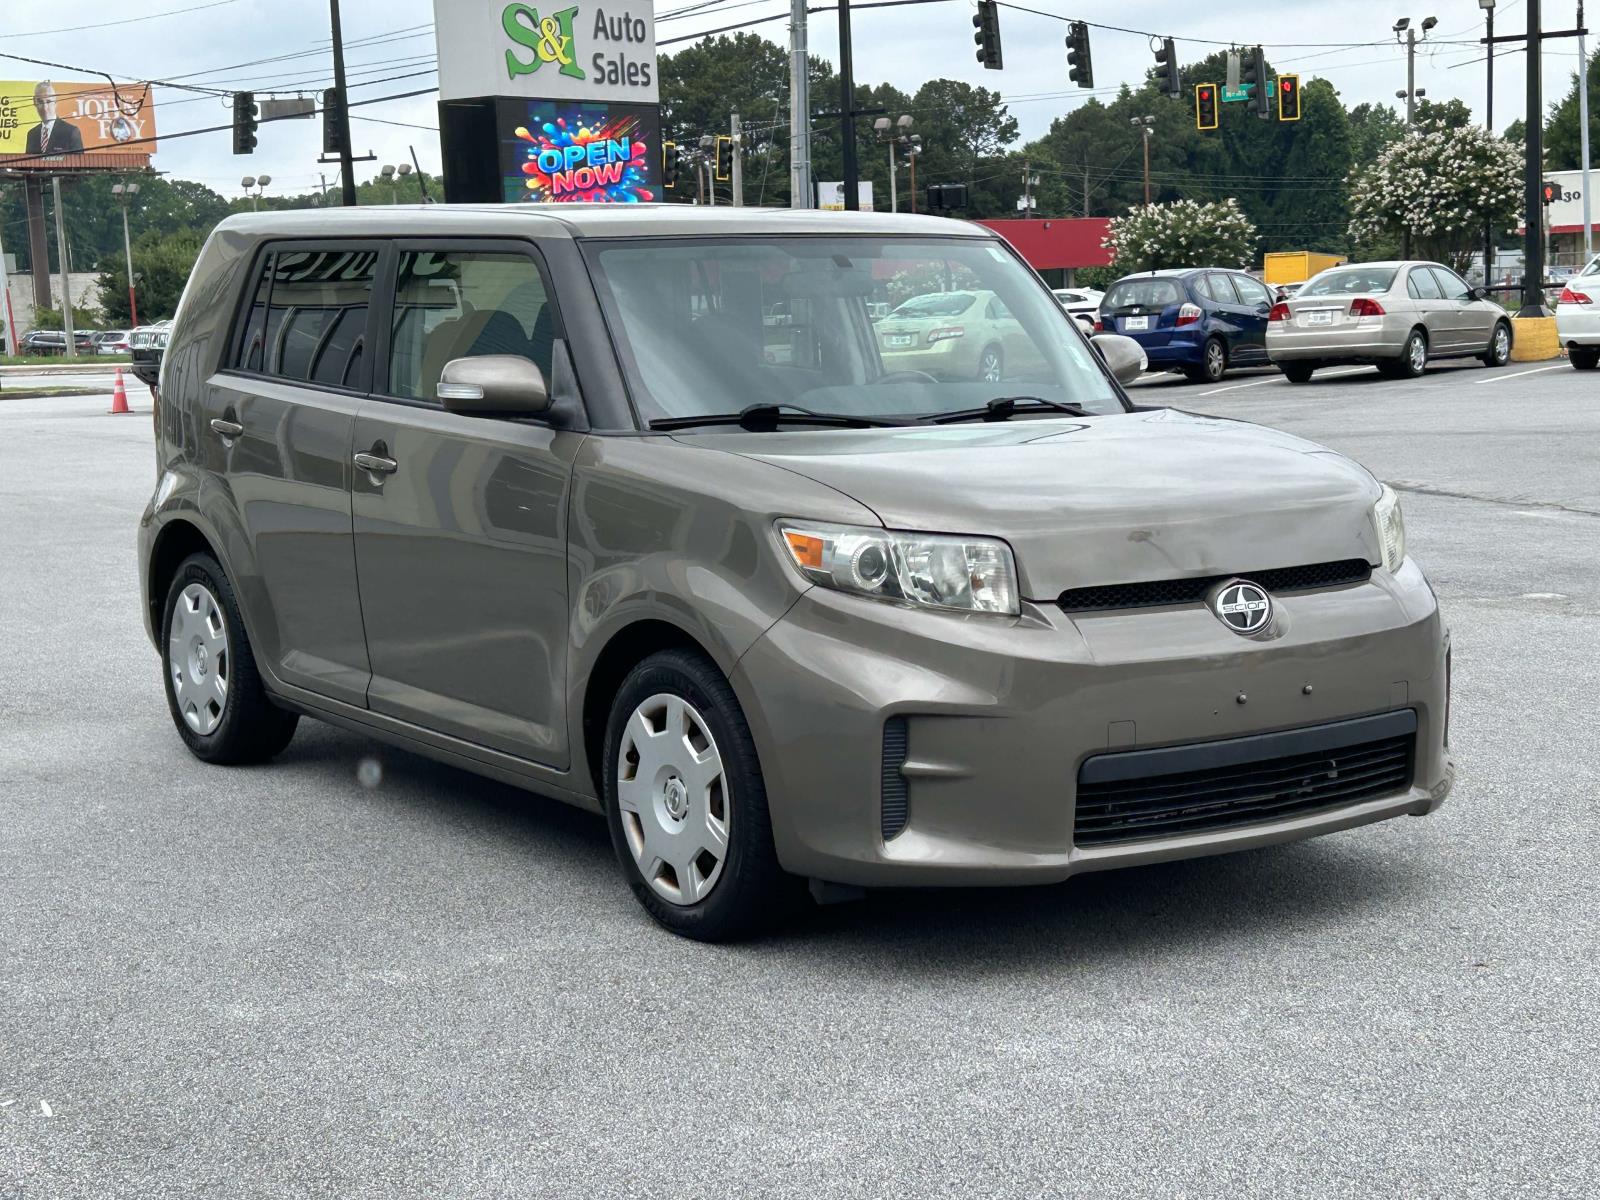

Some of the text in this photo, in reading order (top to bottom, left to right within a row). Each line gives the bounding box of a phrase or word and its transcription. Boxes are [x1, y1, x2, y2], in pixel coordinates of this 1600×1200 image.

[593, 8, 646, 43] Auto
[592, 52, 651, 87] Sales
[537, 136, 631, 174] OPEN
[552, 161, 623, 194] NOW
[1222, 601, 1267, 613] SCION
